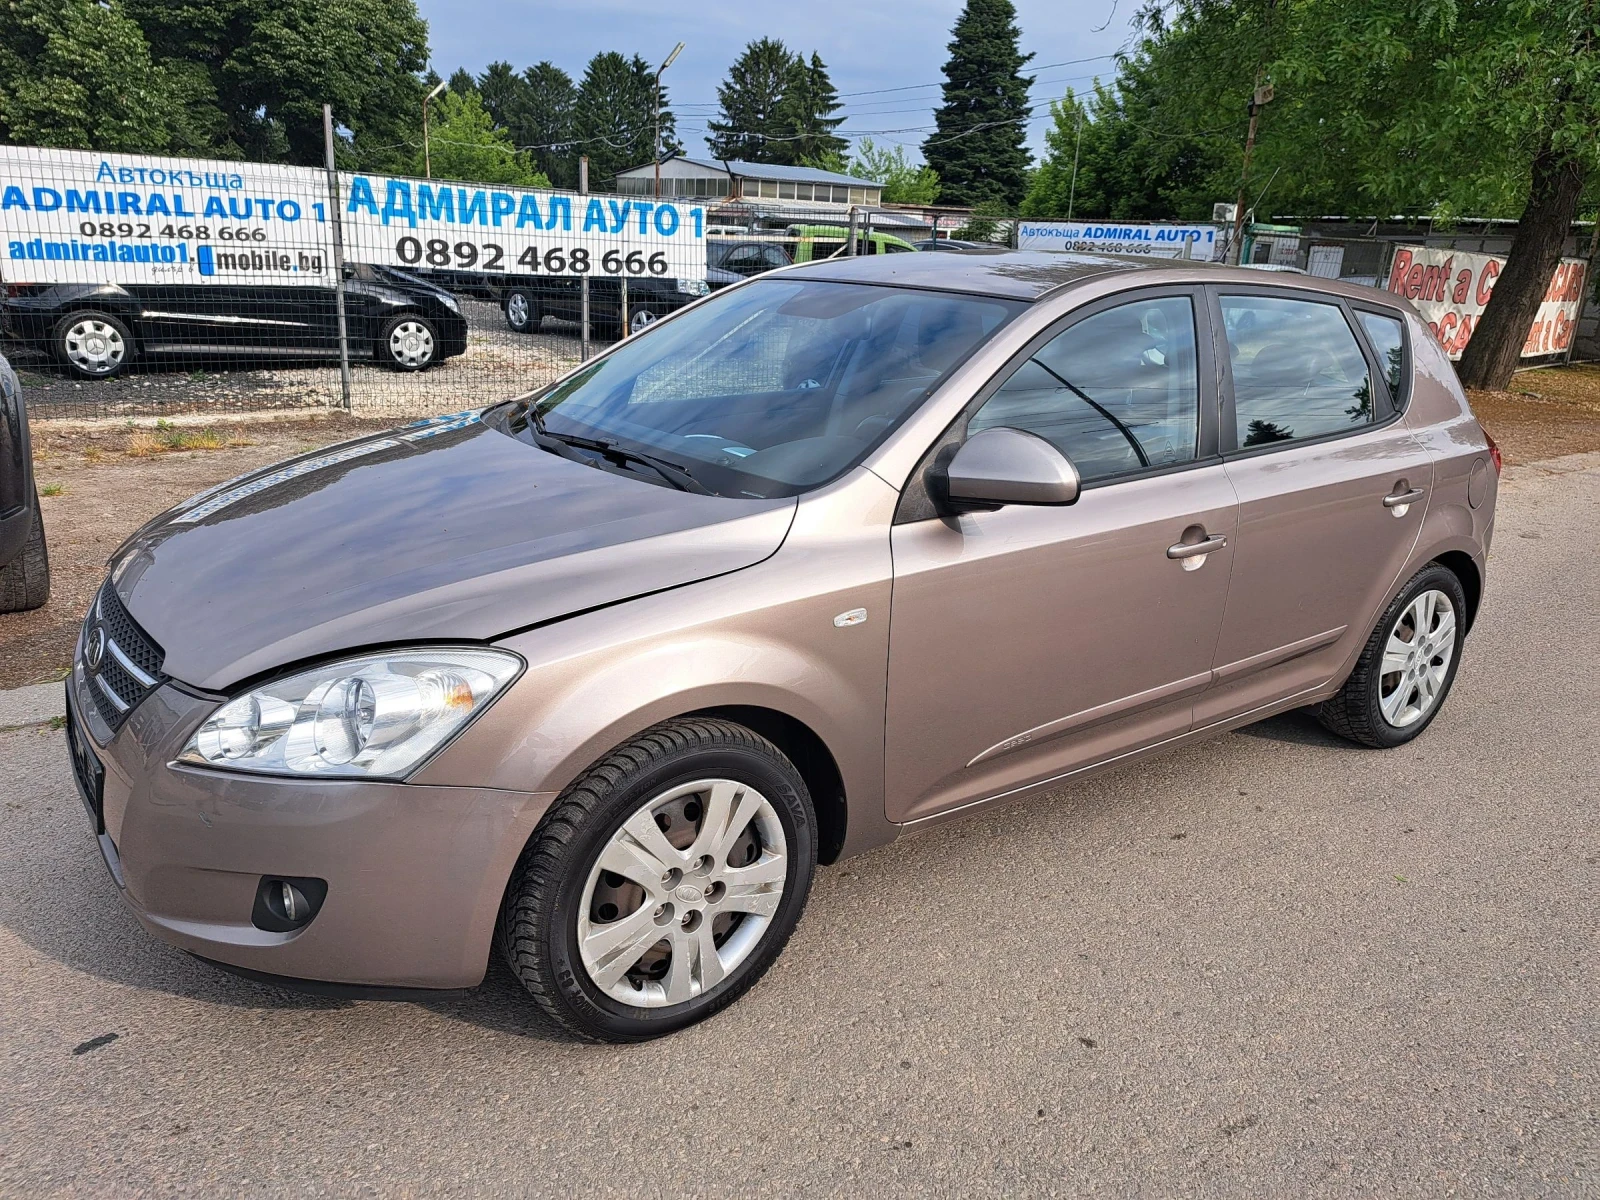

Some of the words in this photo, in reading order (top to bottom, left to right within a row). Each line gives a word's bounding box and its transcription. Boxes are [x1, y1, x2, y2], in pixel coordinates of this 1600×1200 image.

[97, 162, 243, 191] Автокъща
[1, 186, 195, 218] ADMIRAL
[203, 196, 302, 223] AUTO
[312, 203, 325, 222] 1
[347, 177, 572, 232] АДМИРАЛ
[583, 199, 680, 237] АУТО
[690, 207, 703, 238] 1
[80, 221, 151, 239] 0892
[160, 224, 211, 240] 468
[218, 226, 267, 242] 666
[1020, 225, 1080, 239] Автокъща
[1083, 227, 1151, 241] ADMIRAL
[1155, 229, 1202, 243] AUTO
[1206, 231, 1214, 243] 1
[396, 236, 504, 270] 0892
[518, 246, 590, 274] 468
[602, 250, 669, 276] 666
[1388, 249, 1454, 302] Rent
[1452, 269, 1473, 304] a
[1476, 260, 1500, 306] C
